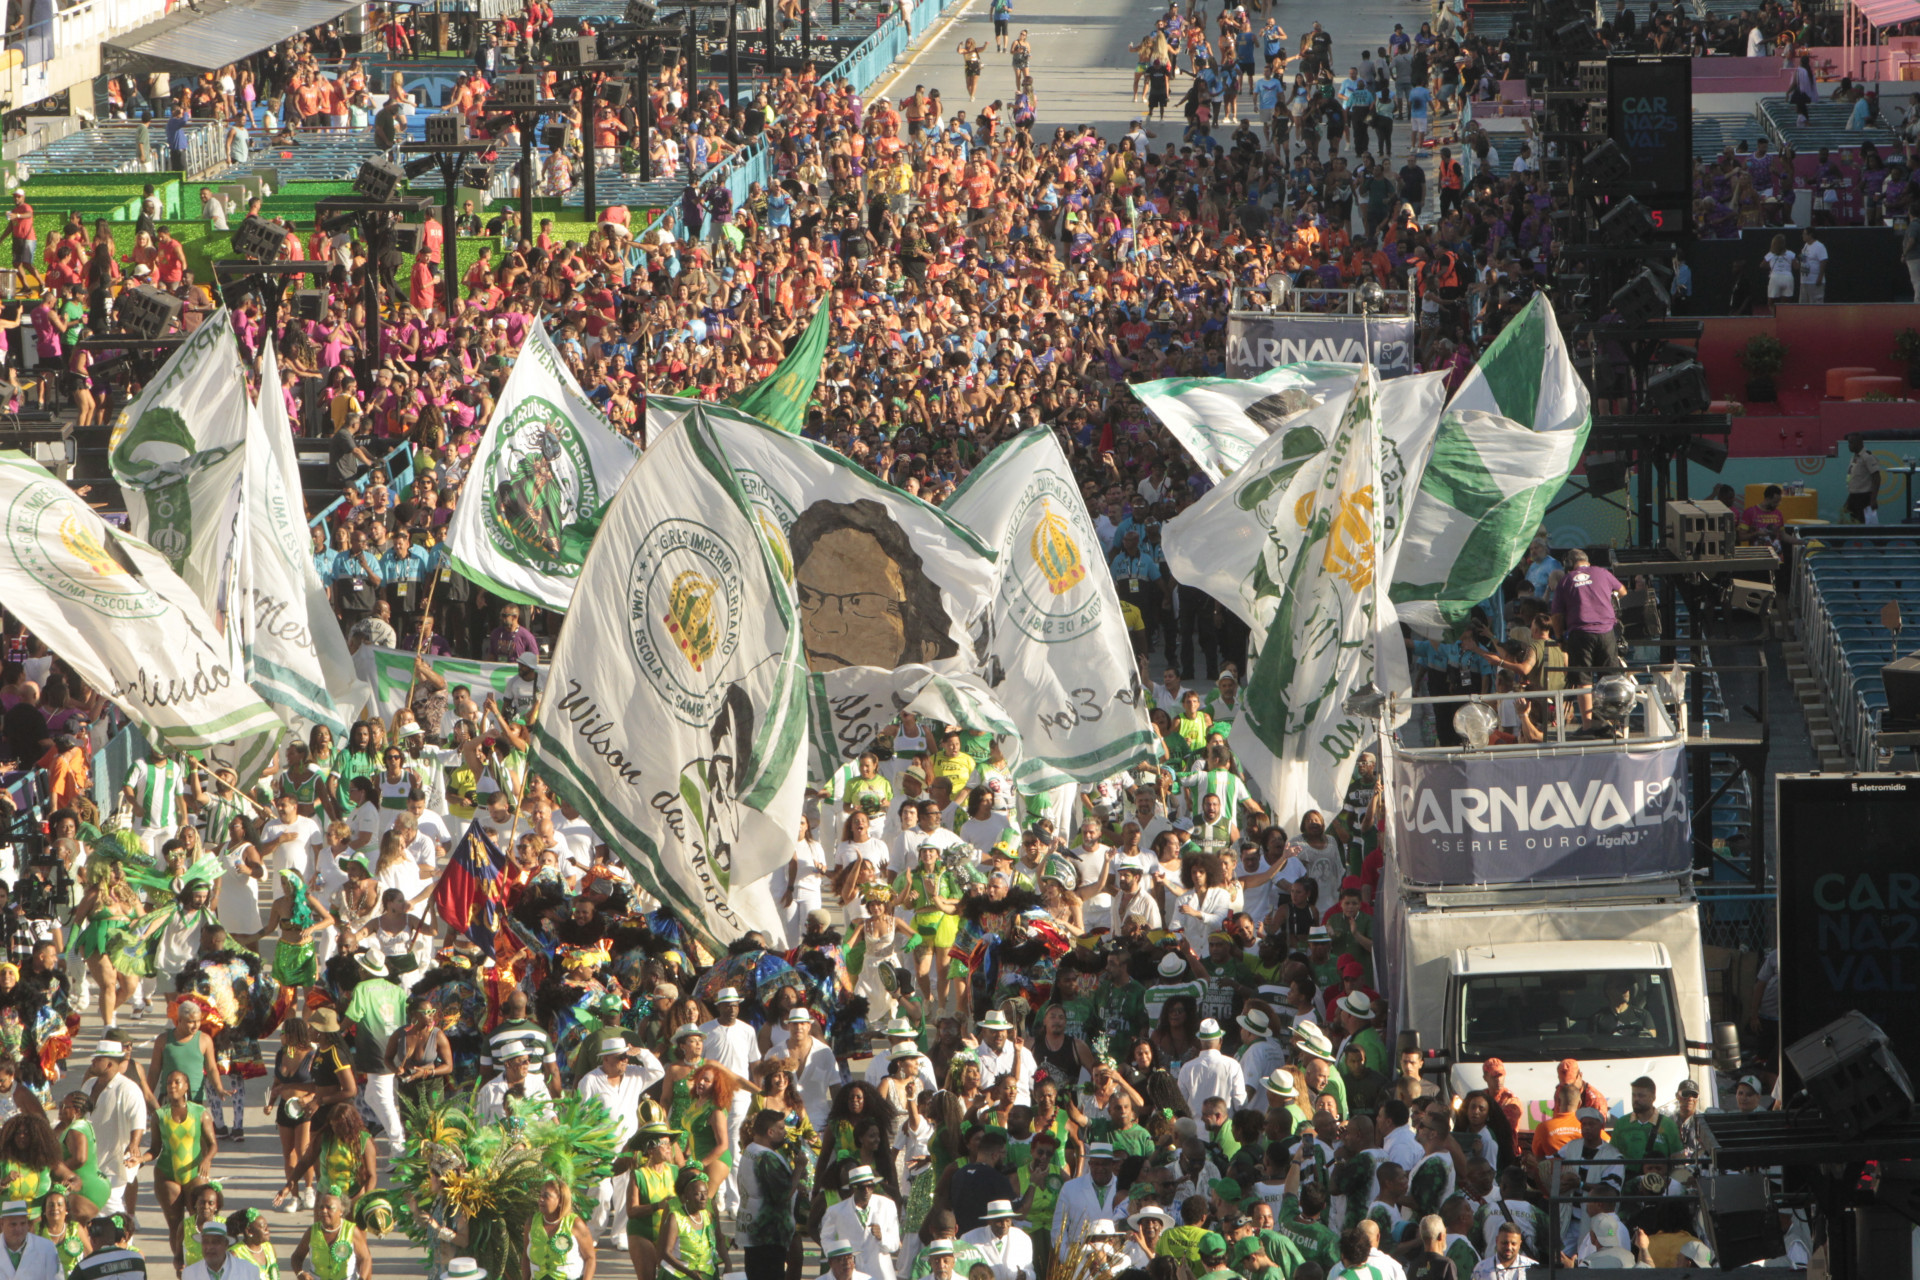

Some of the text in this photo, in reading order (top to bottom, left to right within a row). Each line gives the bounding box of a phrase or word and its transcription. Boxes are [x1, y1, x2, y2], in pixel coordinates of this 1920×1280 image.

[1622, 97, 1668, 113] CAR
[1626, 132, 1665, 148] VAL
[554, 415, 573, 442] DO
[570, 440, 595, 519] REIZINHO
[740, 474, 769, 501] ÉRIO
[273, 495, 288, 529] UMA
[58, 579, 86, 599] UMA
[92, 594, 144, 612] ESCOLA
[632, 589, 644, 621] UMA
[721, 575, 739, 656] SERRANO
[634, 629, 664, 681] ESCOLA
[557, 678, 642, 786] Wilson
[1858, 783, 1906, 792] eletromidia
[1401, 780, 1662, 834] CARNAVAL
[1442, 833, 1640, 852] SÉRIE OURO LigaRJ
[1813, 872, 1920, 912] CAR
[1819, 955, 1918, 992] VAL
